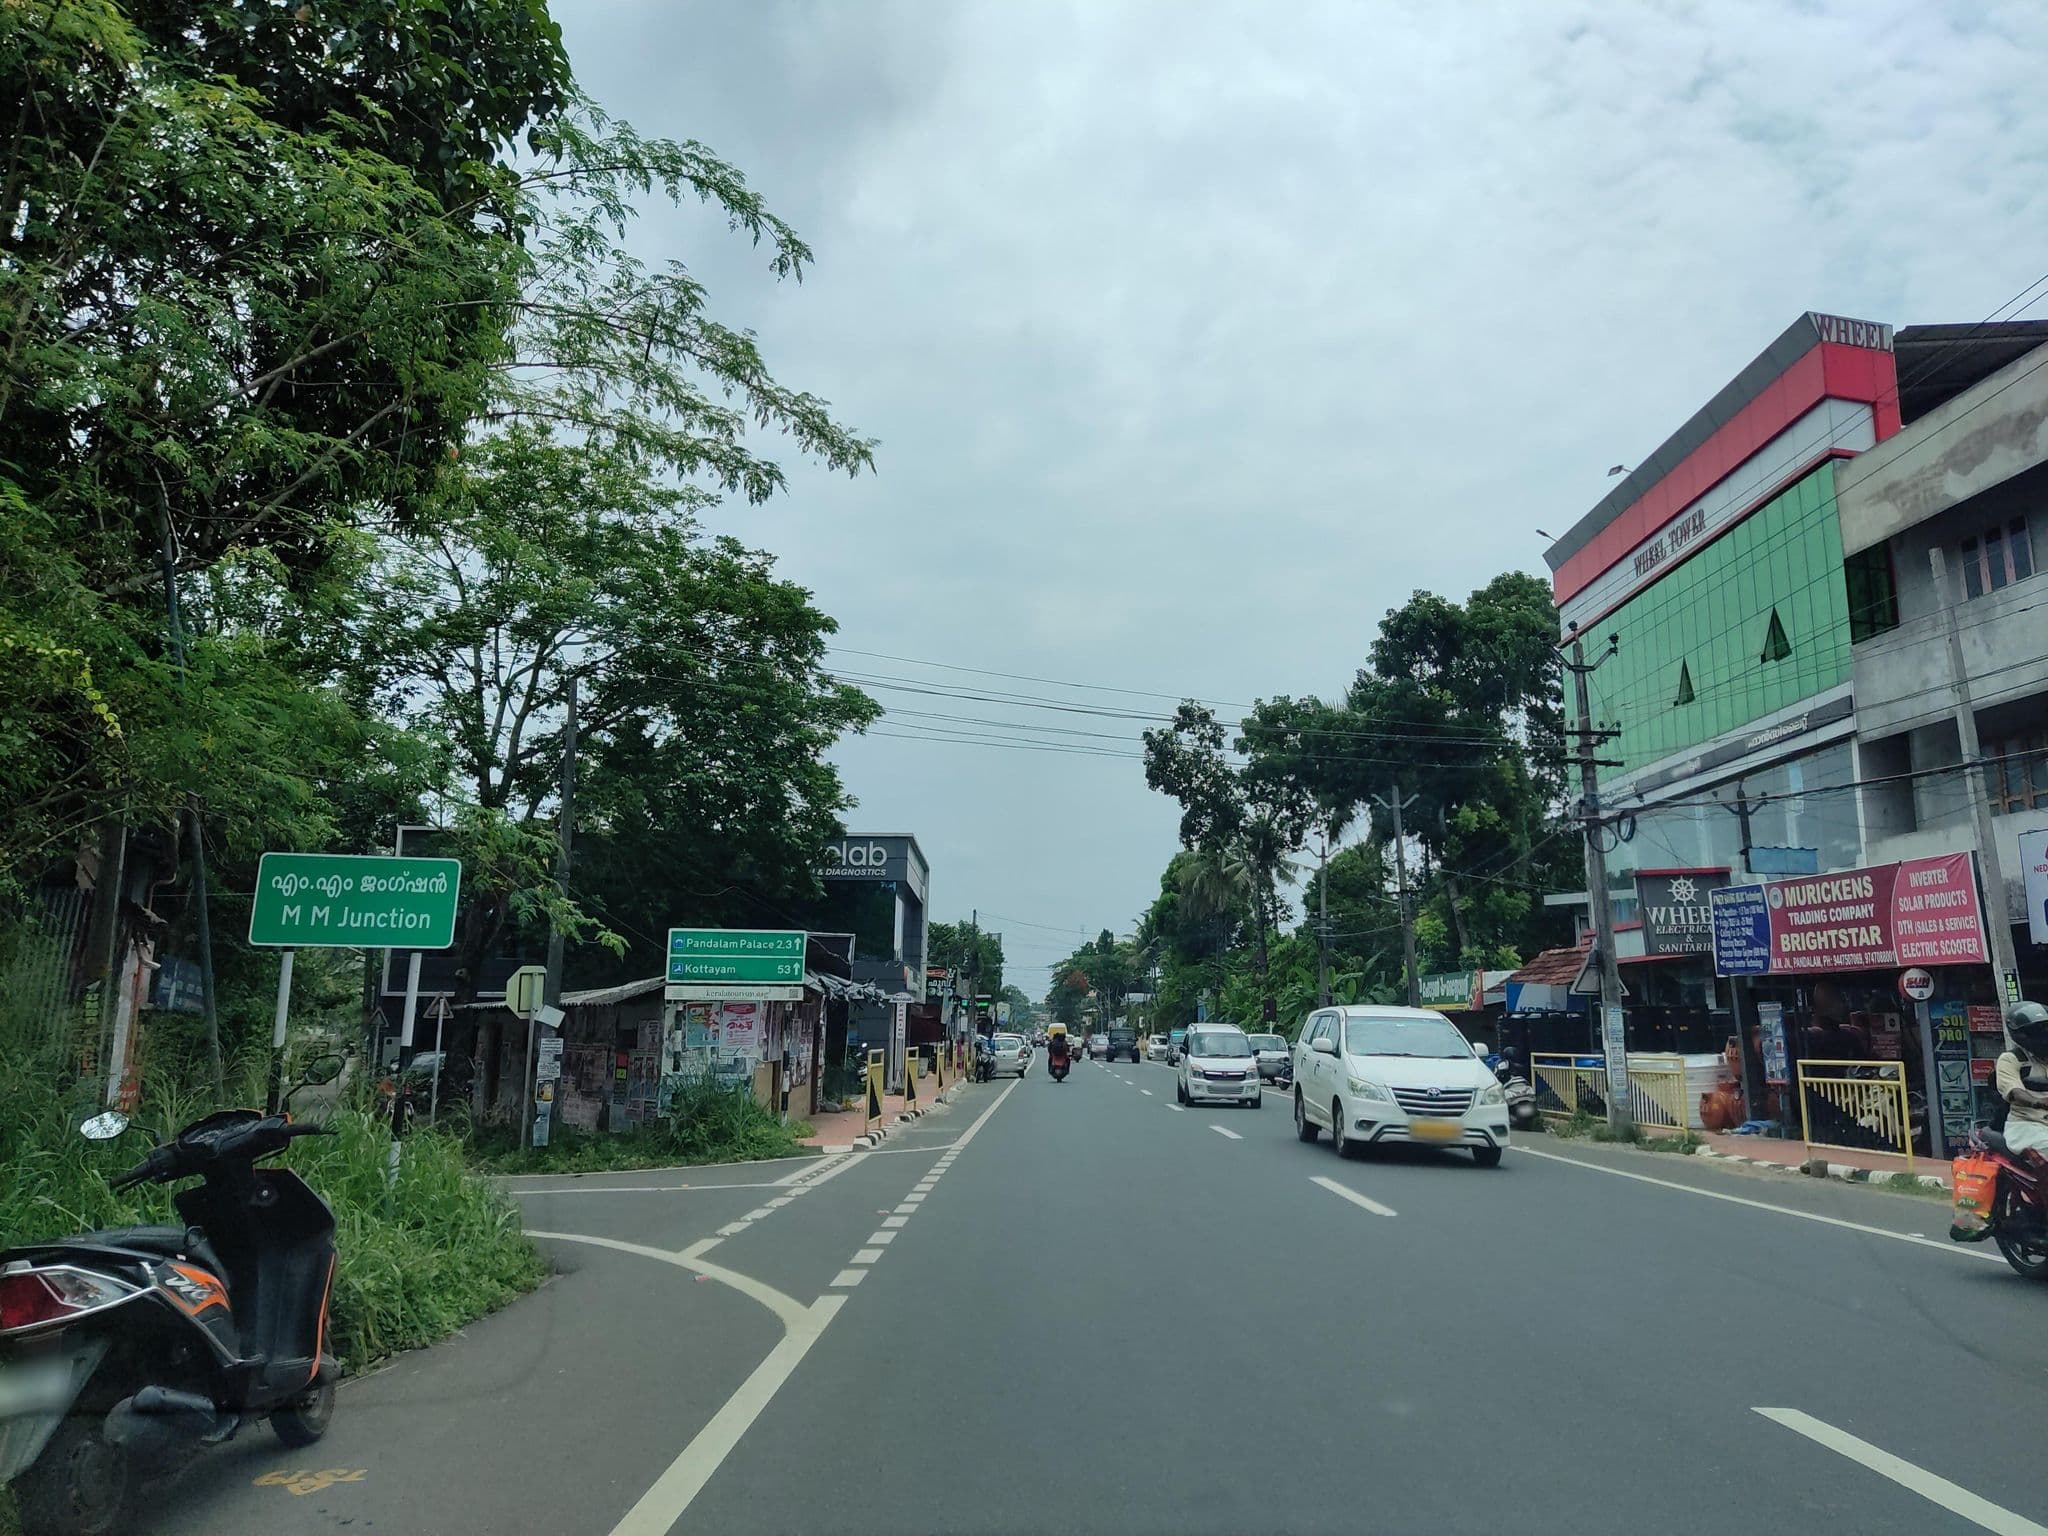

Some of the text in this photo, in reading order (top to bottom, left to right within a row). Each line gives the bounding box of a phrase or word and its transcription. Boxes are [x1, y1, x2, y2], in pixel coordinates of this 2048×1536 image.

[1815, 313, 1893, 352] WHEEL
[1634, 508, 1706, 578] WHEEL TOWER
[825, 868, 887, 876] DIAGNOSTICS
[1909, 868, 1949, 888] INVERTER
[1784, 875, 1874, 907] MURICKENS
[1898, 889, 1968, 912] SOLAR PRODUCTS
[281, 905, 431, 929] M M Junction
[1788, 903, 1875, 926] TRADING COMPANY
[686, 938, 738, 949] Pandalam
[740, 939, 775, 949] Palace
[1685, 934, 1693, 942] &
[1780, 925, 1883, 952] BRIGHTSTAR
[1901, 937, 1979, 958] ELECTRIC SCOOTER
[685, 964, 791, 975] Kottayam 53
